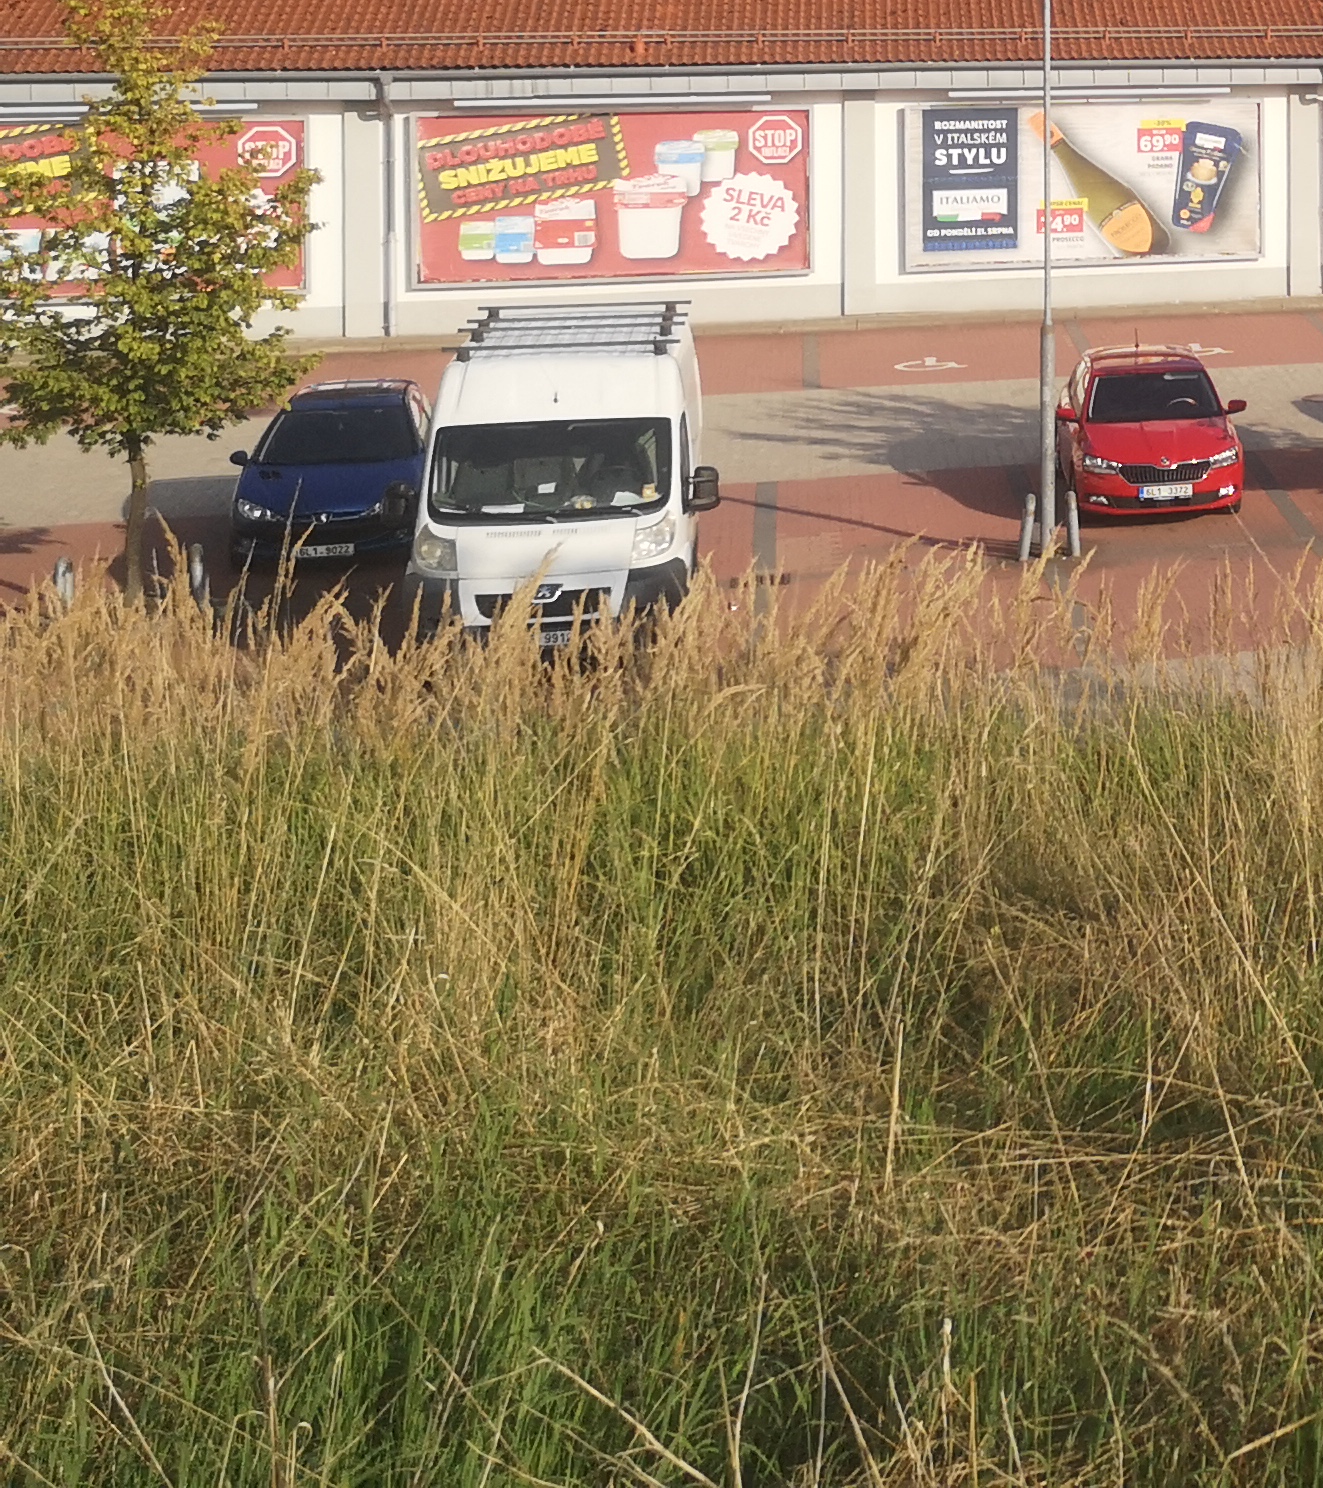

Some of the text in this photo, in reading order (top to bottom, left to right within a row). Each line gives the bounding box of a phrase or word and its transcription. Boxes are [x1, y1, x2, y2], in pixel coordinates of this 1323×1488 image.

[934, 120, 1008, 130] ROZMANITOST
[754, 129, 796, 147] STOP
[934, 130, 1008, 145] V ITALSKÉM
[934, 147, 1007, 165] STYLU
[438, 143, 599, 190] SNIŽUJEME
[452, 182, 507, 205] CENY
[509, 176, 541, 195] NA
[723, 187, 786, 213] SLEVA
[939, 195, 1001, 205] ITALIAMO
[729, 206, 772, 227] 2 Kč
